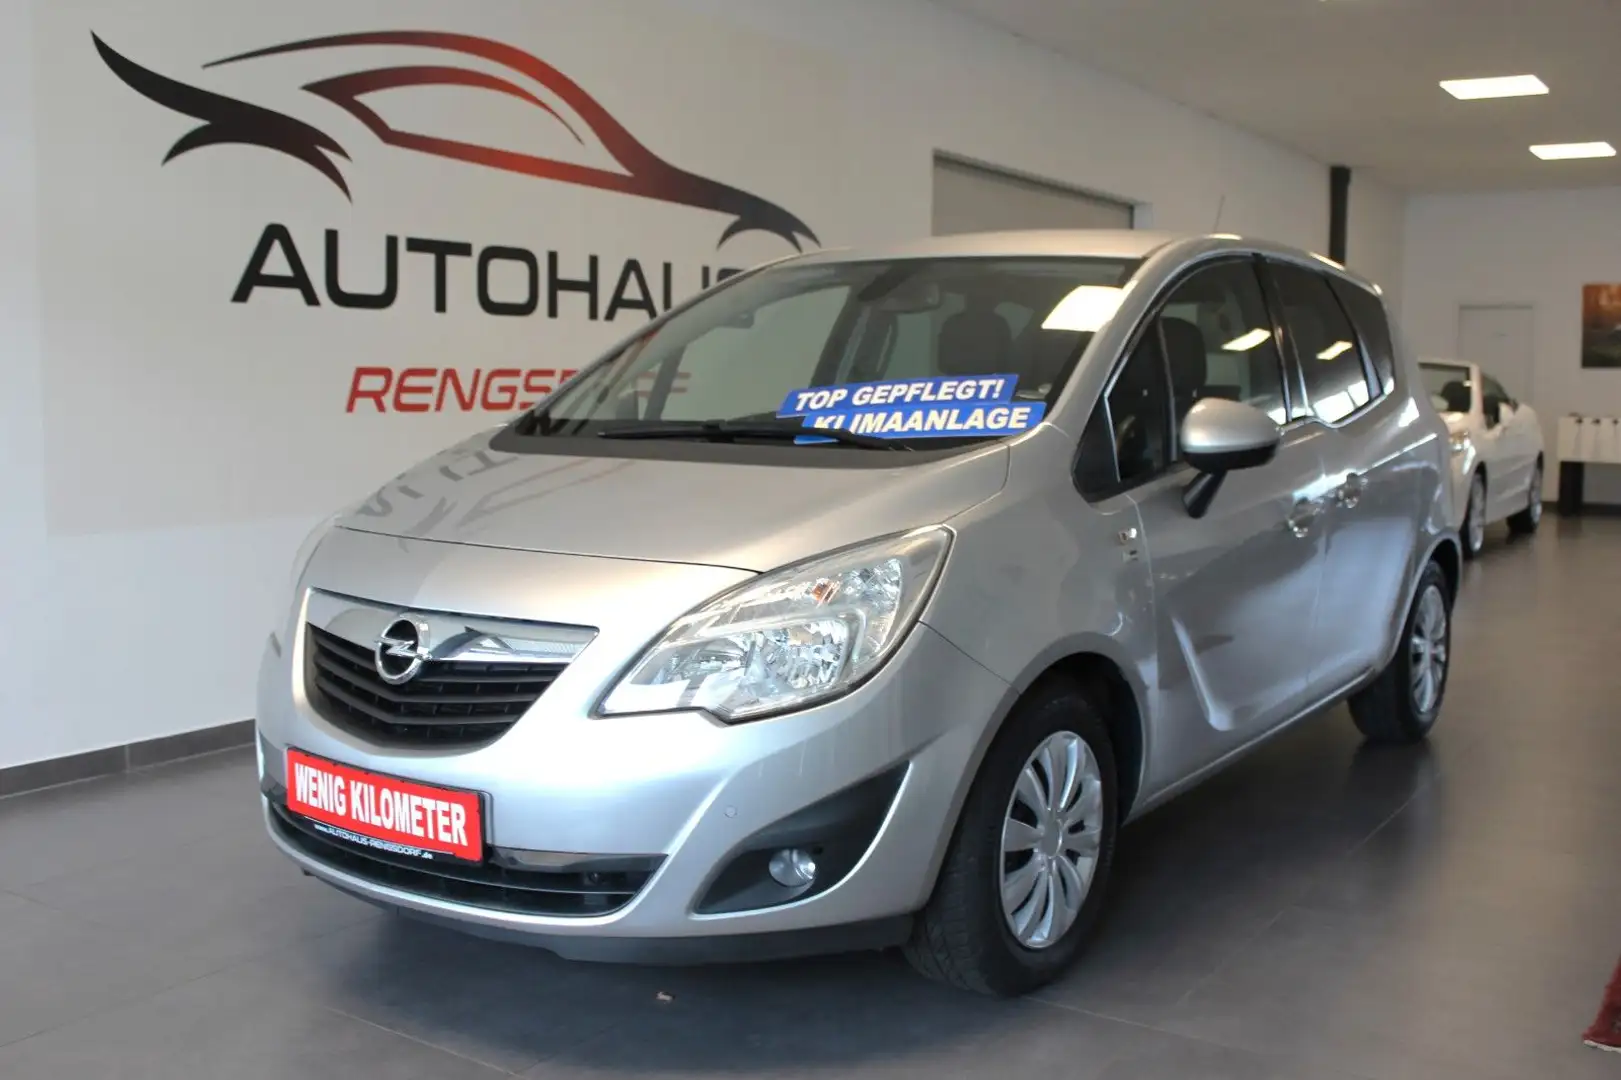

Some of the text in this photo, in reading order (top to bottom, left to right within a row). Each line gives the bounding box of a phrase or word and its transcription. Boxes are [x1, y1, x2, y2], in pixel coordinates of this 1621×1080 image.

[796, 378, 1005, 412] TOP GEPFLEGT!
[294, 762, 468, 847] WENIG KILOMETER
